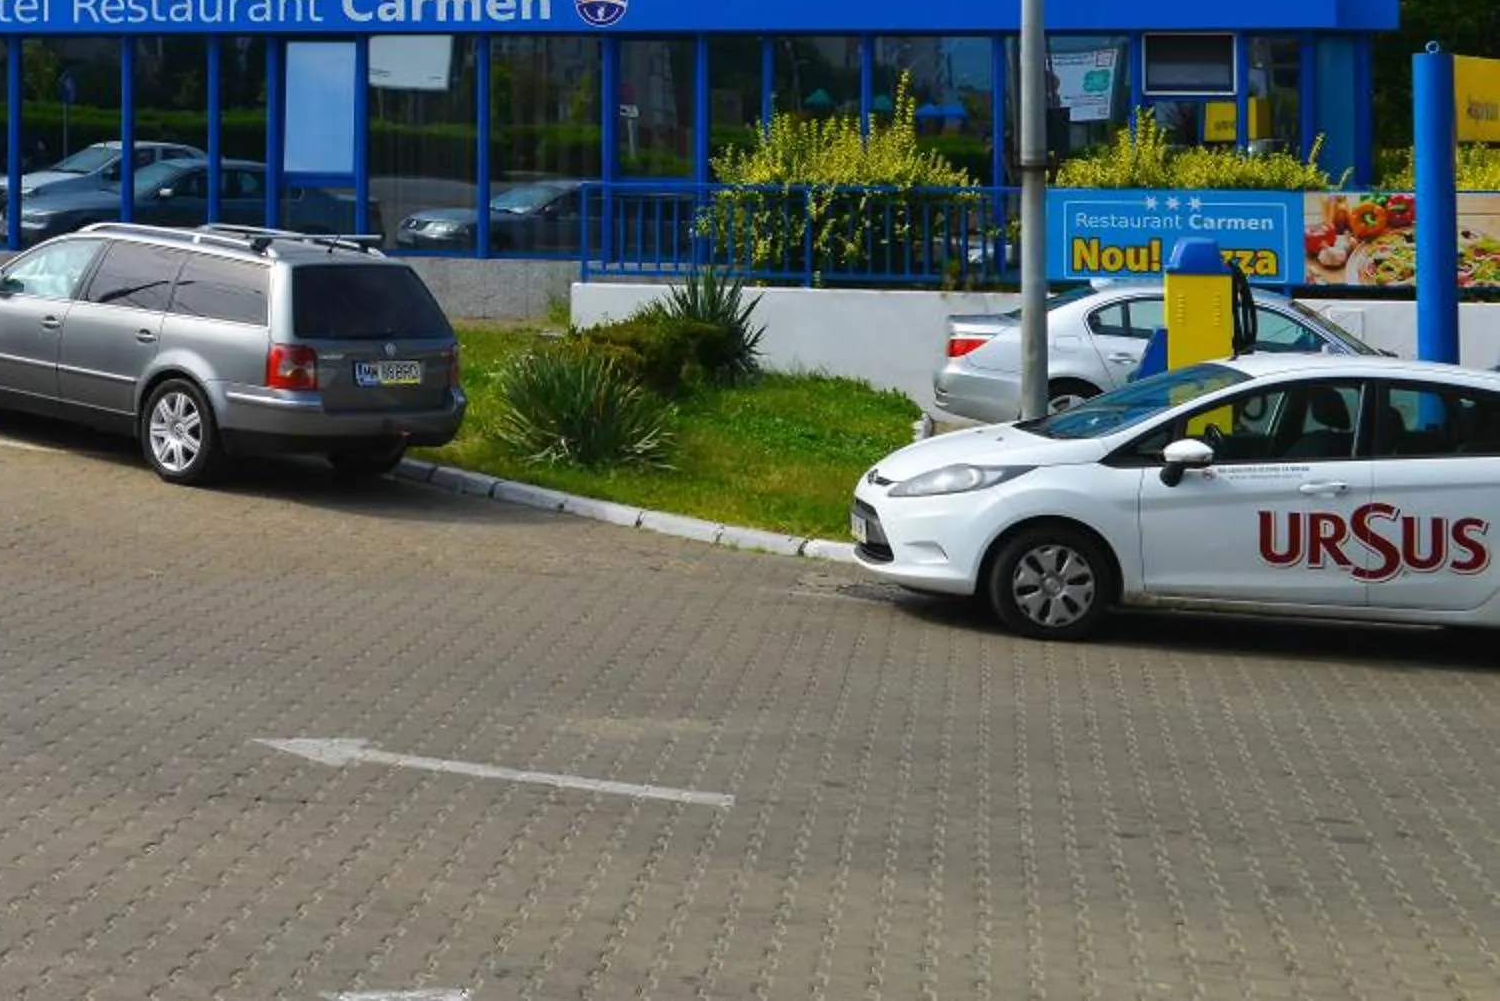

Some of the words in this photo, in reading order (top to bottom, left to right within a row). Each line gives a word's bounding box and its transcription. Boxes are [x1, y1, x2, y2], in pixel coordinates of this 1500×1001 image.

[1075, 212, 1182, 229] Restaurant
[1188, 214, 1274, 230] Carmen
[1072, 236, 1163, 273] Nou!
[1258, 502, 1491, 583] URSUS
